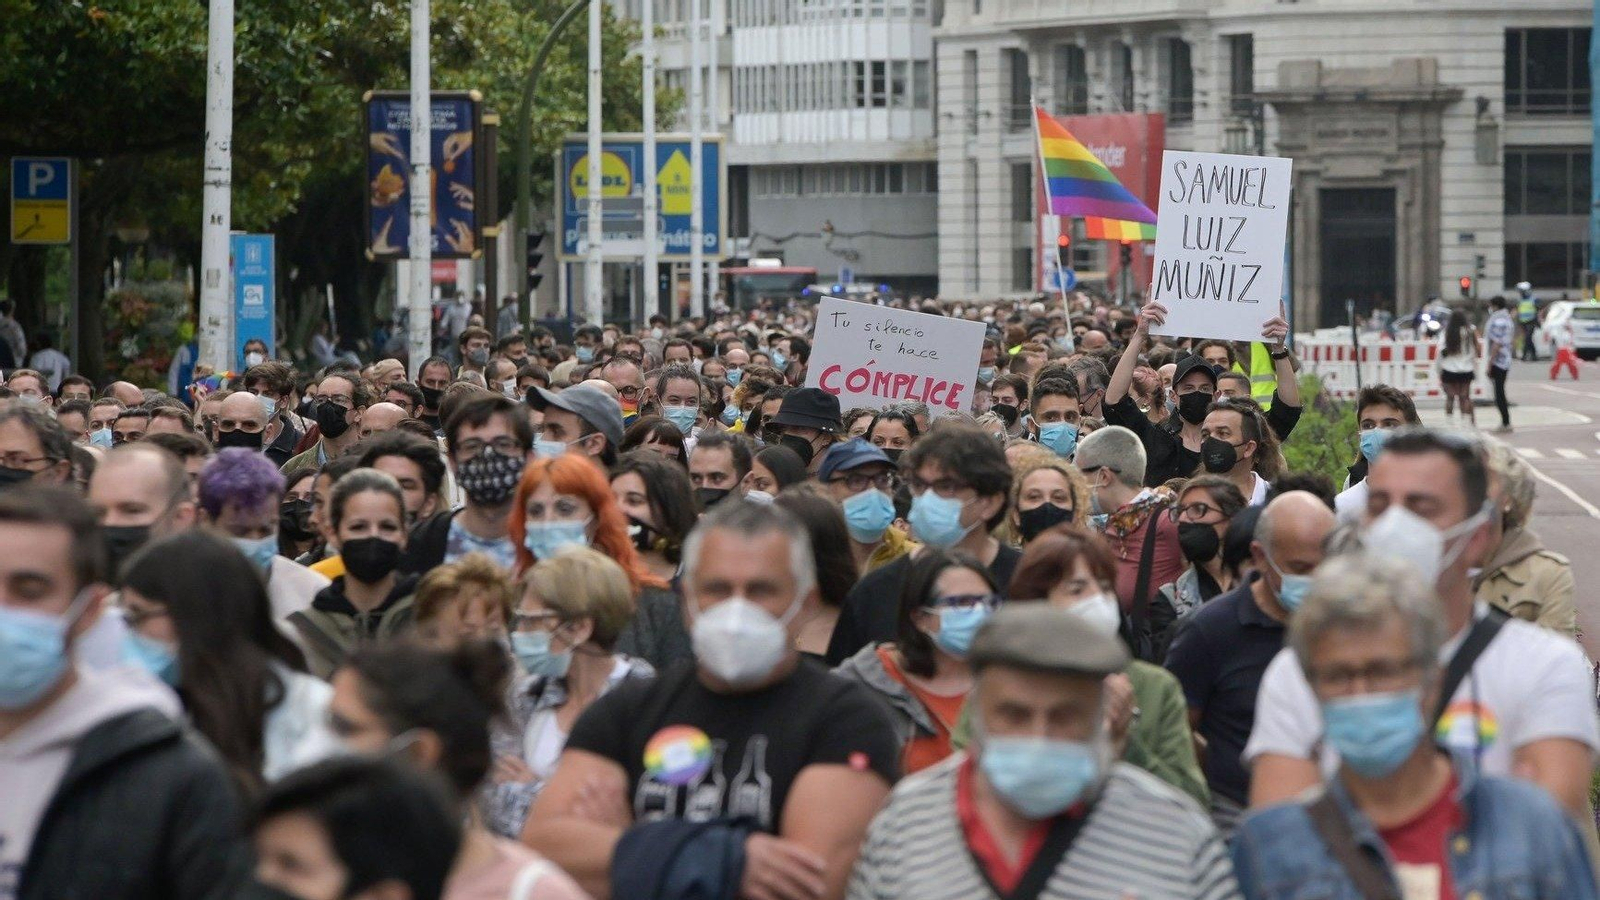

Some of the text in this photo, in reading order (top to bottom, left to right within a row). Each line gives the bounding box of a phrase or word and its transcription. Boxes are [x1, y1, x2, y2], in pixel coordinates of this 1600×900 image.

[29, 163, 55, 196] P
[575, 174, 626, 187] LDL
[1169, 160, 1275, 209] SAMUEL
[1183, 215, 1247, 254] LUIZ
[1155, 255, 1262, 303] MUÑIZ
[831, 312, 924, 338] Tu silencio
[869, 339, 939, 359] te hace
[819, 360, 965, 410] CÓMPLICE
